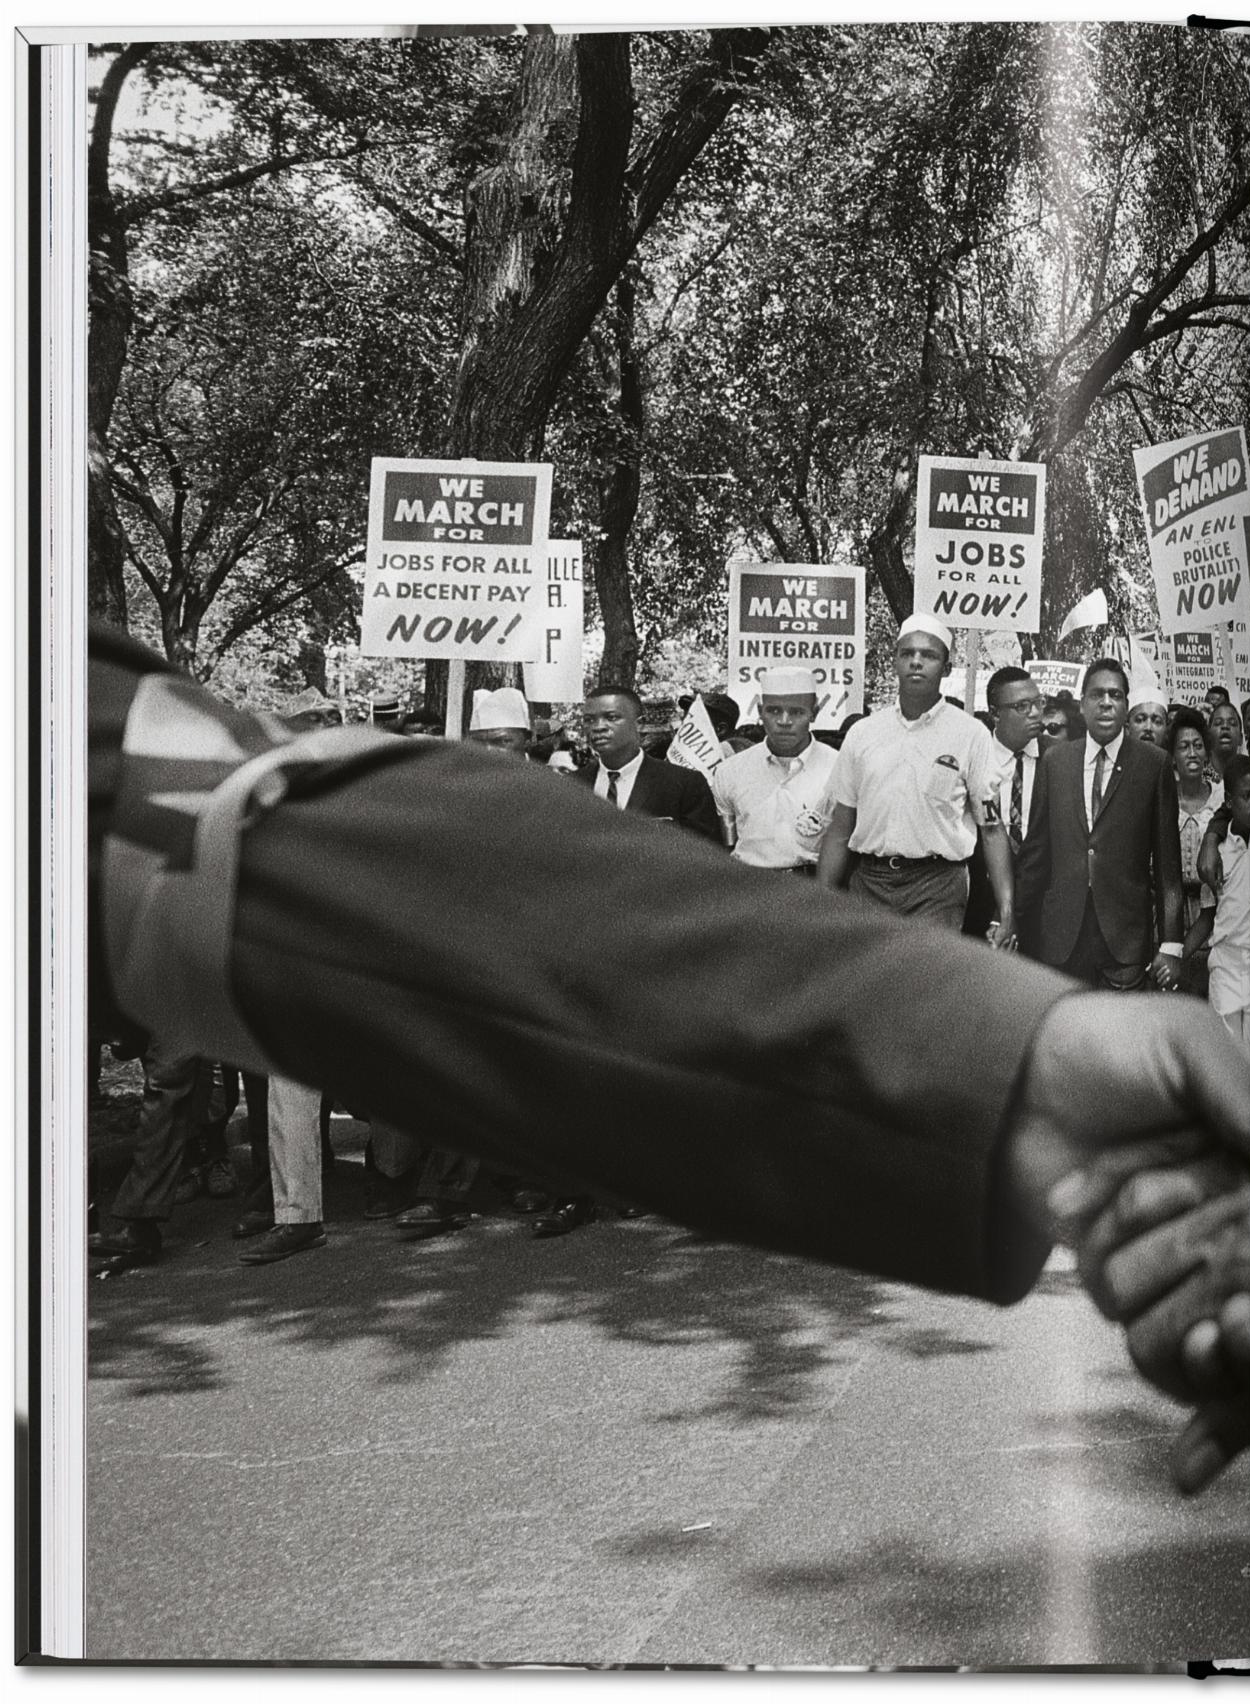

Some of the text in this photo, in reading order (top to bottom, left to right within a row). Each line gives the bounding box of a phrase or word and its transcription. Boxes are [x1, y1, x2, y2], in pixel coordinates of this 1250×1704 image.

[1173, 444, 1209, 484] WE
[438, 478, 484, 498] WE
[968, 474, 1000, 493] WE
[1154, 458, 1242, 527] DEMAND
[393, 499, 525, 527] MARCH
[936, 492, 1029, 518] MARCH
[433, 527, 484, 541] FOR
[965, 517, 1001, 530] FOR
[1165, 524, 1194, 547] AN
[377, 553, 533, 575] JOBS FOR ALL
[935, 540, 1026, 569] JOBS
[1183, 541, 1231, 566] POLICE
[782, 578, 818, 597] WE
[937, 570, 1022, 585] FOR ALL
[372, 582, 531, 602] A DECENT PAY
[1176, 573, 1242, 617] NOW
[748, 597, 848, 619] MARCH
[933, 590, 1028, 618] NOW!
[386, 613, 522, 645] NOW!
[779, 620, 819, 632] FOR
[739, 639, 856, 660] INTEGRATED
[1186, 634, 1199, 644] WE
[1177, 644, 1210, 656] MARCH
[739, 666, 854, 686] SCOLS
[1030, 671, 1075, 683] MARCH
[1175, 666, 1215, 677] INTEGRATED
[678, 712, 714, 761] QUAL
